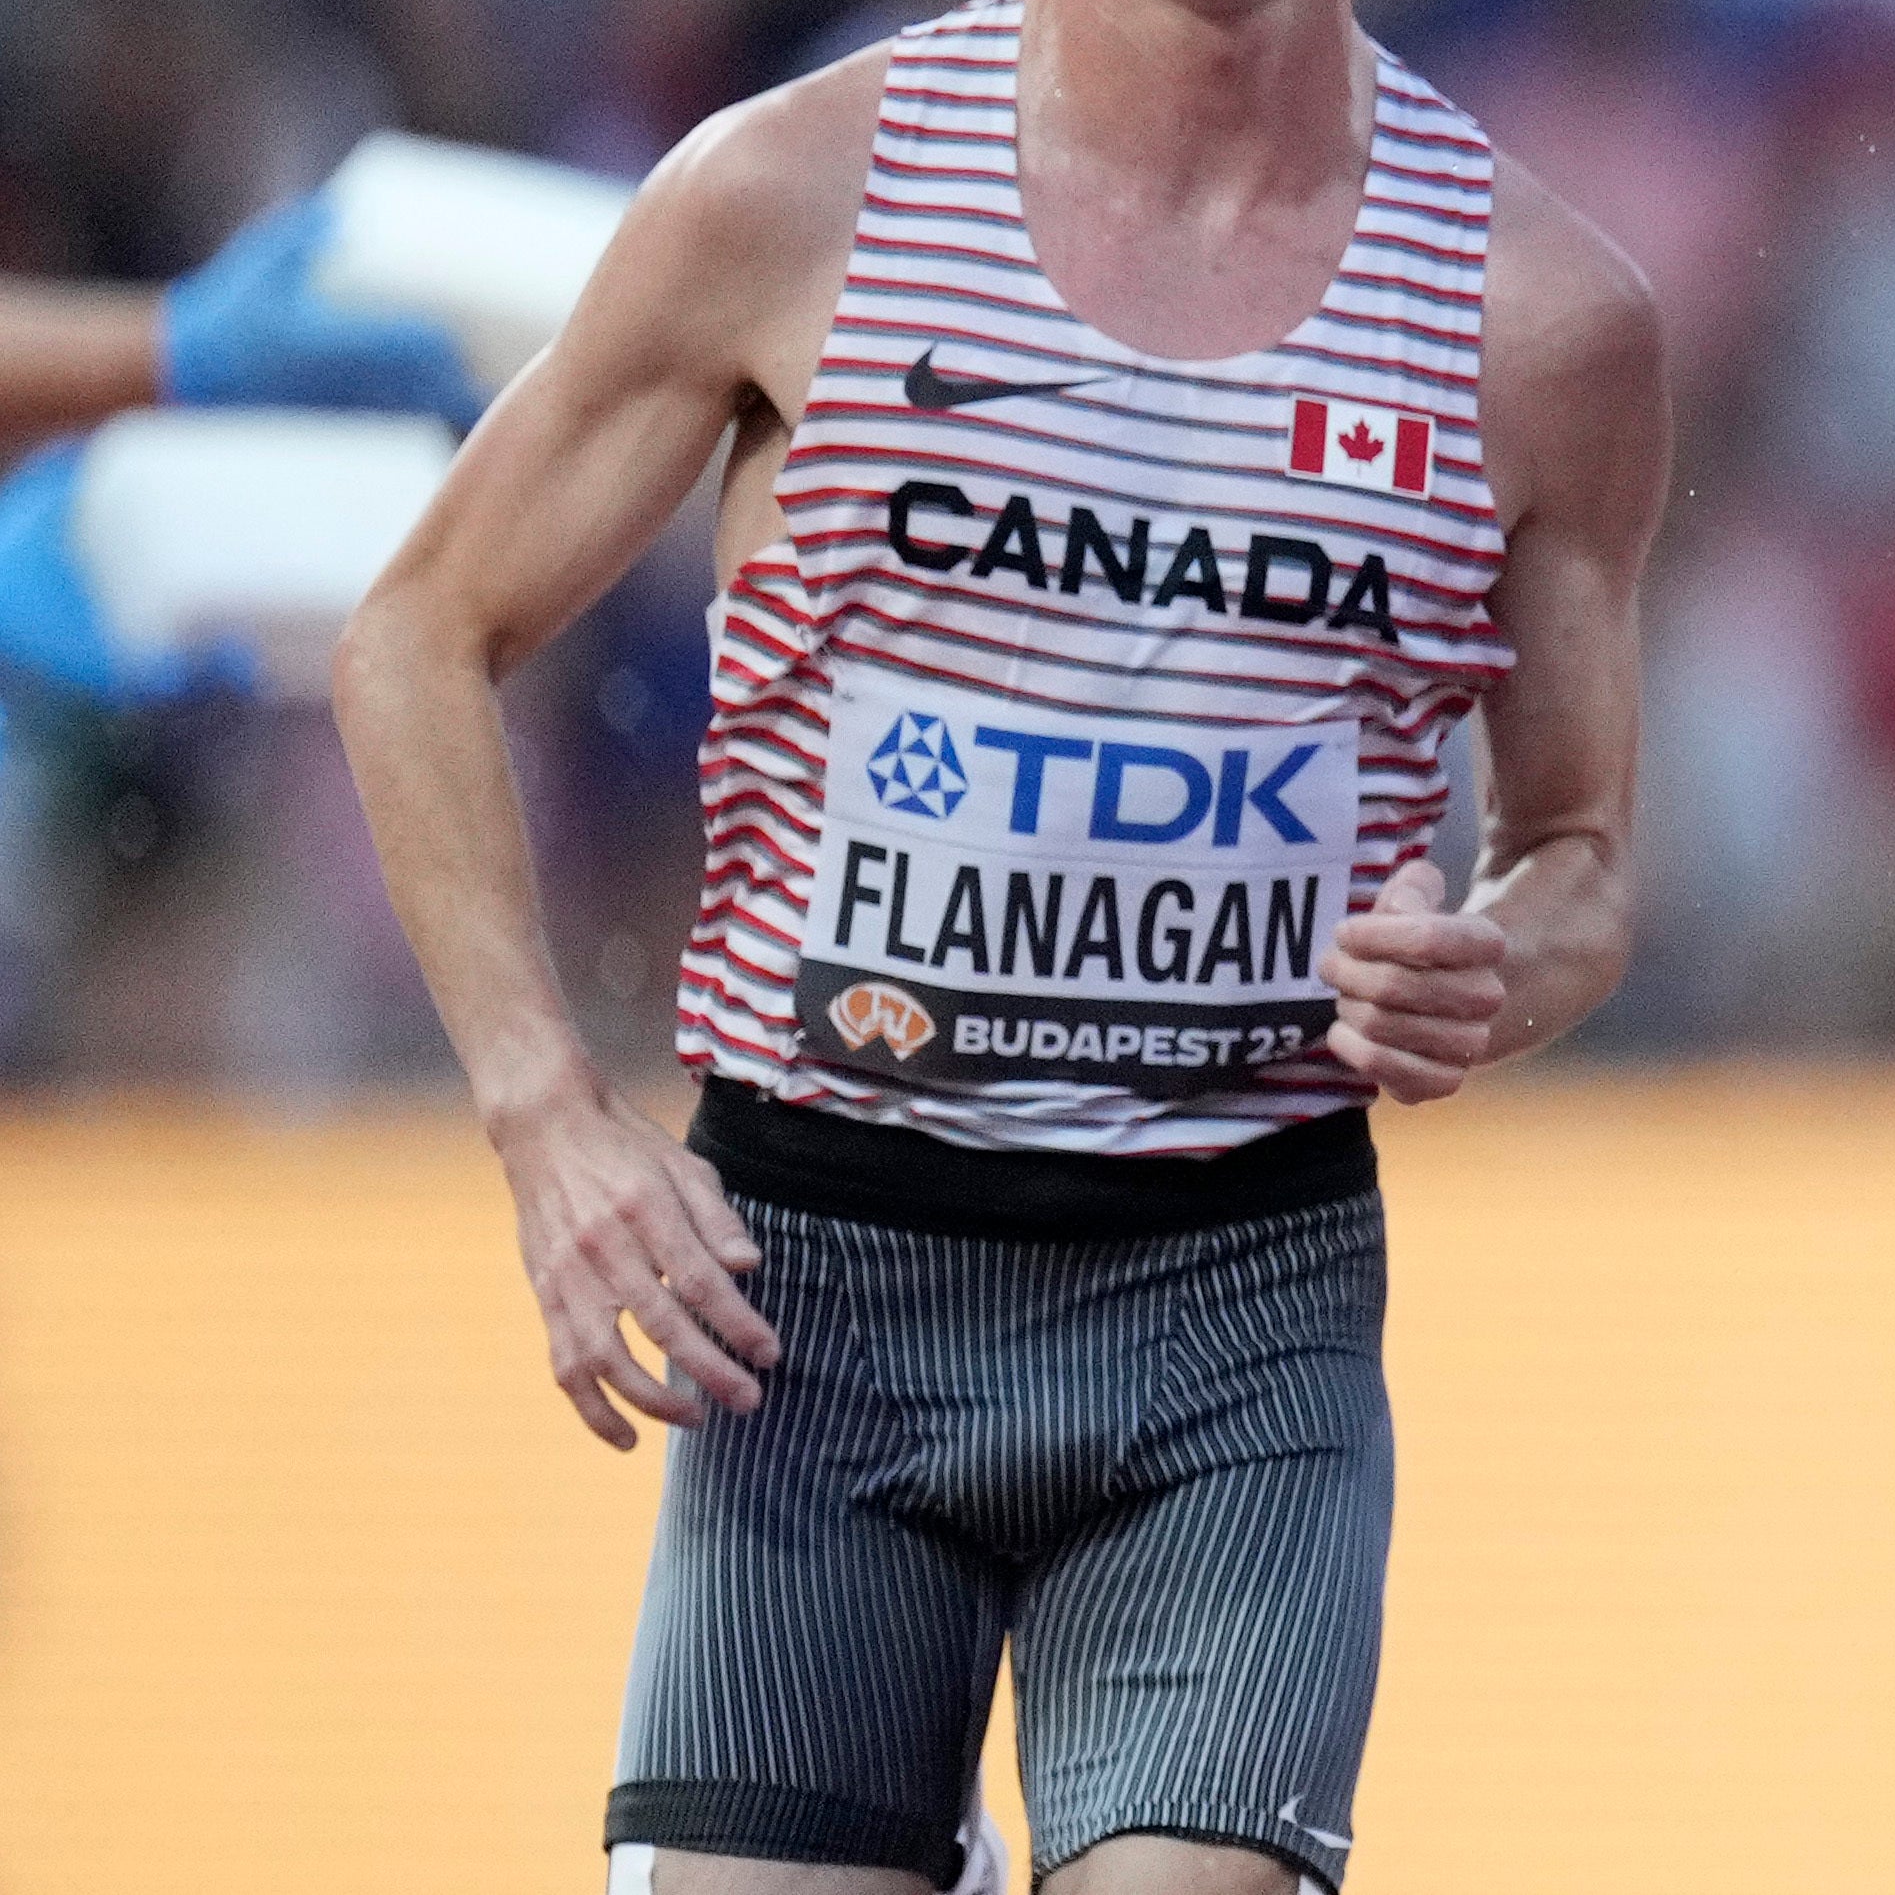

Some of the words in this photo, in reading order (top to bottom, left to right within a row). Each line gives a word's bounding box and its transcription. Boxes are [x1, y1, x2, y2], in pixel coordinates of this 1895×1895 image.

[887, 480, 1401, 644] CANADA
[973, 724, 1324, 848] TDK
[834, 841, 1320, 985] FLANAGAN
